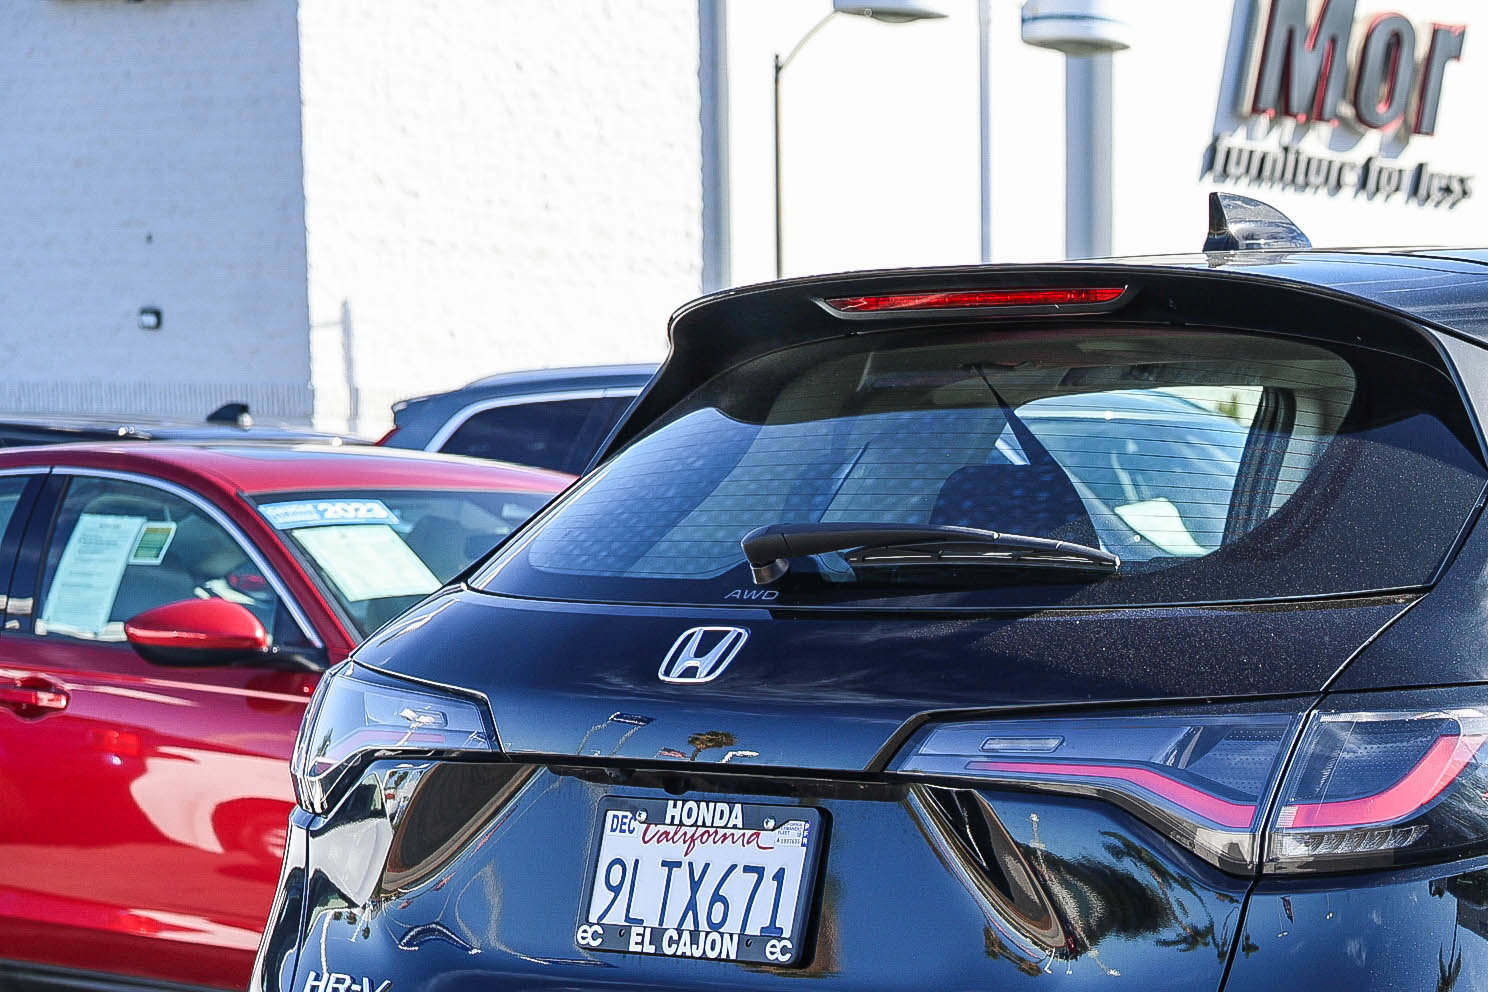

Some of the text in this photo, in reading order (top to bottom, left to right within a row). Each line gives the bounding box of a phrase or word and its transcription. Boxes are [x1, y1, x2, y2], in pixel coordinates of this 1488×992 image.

[1251, 0, 1468, 136] Mor
[724, 590, 779, 600] AWD
[610, 814, 636, 834] DEC
[665, 800, 743, 828] HONDA
[642, 824, 775, 857] California
[597, 858, 786, 937] 9LTX671
[629, 926, 739, 959] EL CAJON
